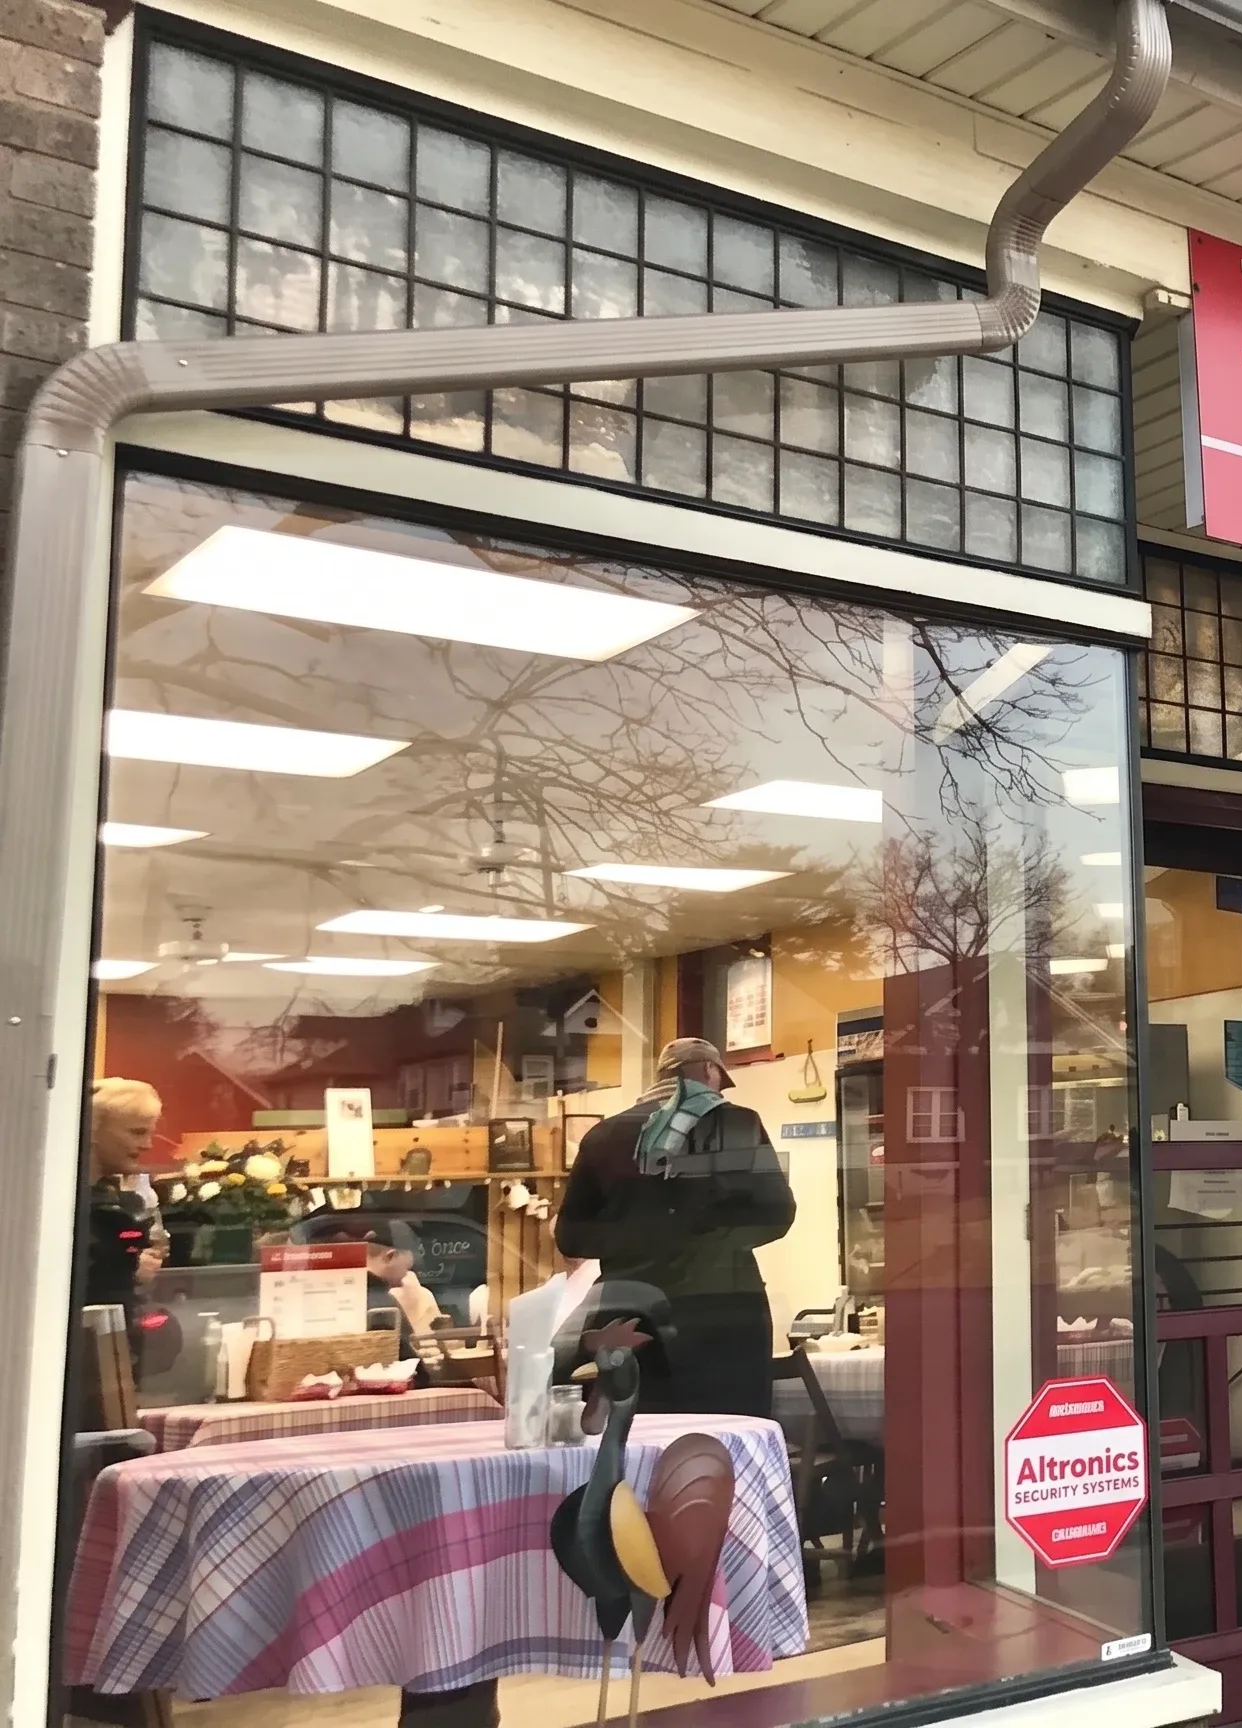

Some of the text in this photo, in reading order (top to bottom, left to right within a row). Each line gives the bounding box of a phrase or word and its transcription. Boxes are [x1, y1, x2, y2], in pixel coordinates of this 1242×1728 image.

[1016, 1446, 1140, 1486] Altronics
[1014, 1475, 1140, 1505] SECURITY SYSTEMS
